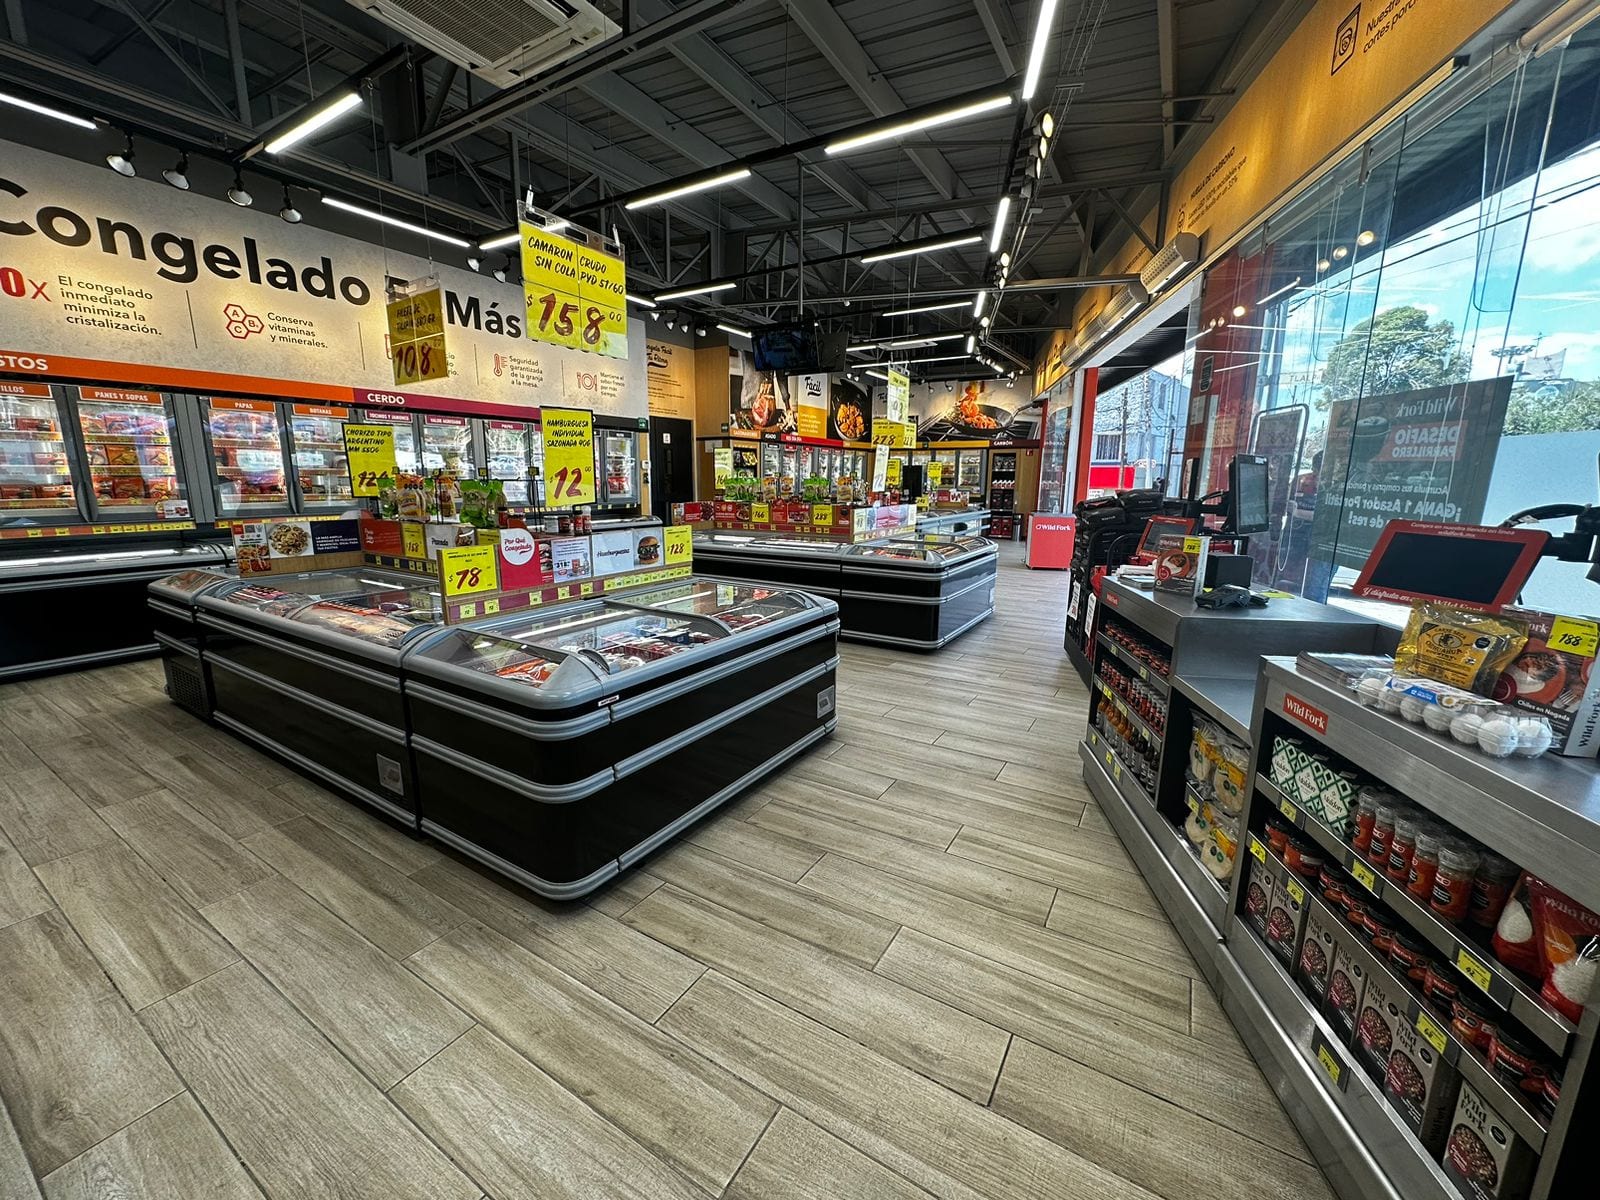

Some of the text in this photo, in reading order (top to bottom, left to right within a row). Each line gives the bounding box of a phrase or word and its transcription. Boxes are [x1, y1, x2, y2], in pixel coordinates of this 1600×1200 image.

[1363, 21, 1391, 53] cortes
[528, 237, 607, 273] CAMARON CRUDO
[535, 256, 552, 270] SIN
[555, 263, 576, 278] COLA
[59, 275, 153, 301] El congelado
[61, 288, 135, 309] inmediato
[64, 302, 146, 322] minimiza la
[267, 312, 314, 327] Conserva
[445, 290, 522, 338] Más
[66, 313, 162, 336] cristalización.
[268, 323, 316, 337] vitaminas
[270, 334, 328, 349] y minerales.
[509, 355, 539, 367] Seguridad
[510, 364, 543, 375] garantizada
[526, 374, 544, 382] granja
[804, 376, 821, 393] Fácil
[95, 391, 117, 399] PANES
[367, 393, 405, 405] CERDO
[346, 429, 374, 437] CHORIZO
[546, 419, 589, 428] HAMBURGUESA
[546, 439, 577, 447] SAZONADA
[1371, 588, 1399, 600] disfruta
[1286, 697, 1326, 730] Wild Fork
[1517, 699, 1536, 711] Chiles
[1544, 708, 1571, 722] Nogada
[1578, 725, 1594, 747] Wild
[1396, 1030, 1416, 1056] Fork
[1398, 1021, 1416, 1046] Wild
[1463, 1087, 1487, 1122] Wild
[1461, 1101, 1486, 1134] Fork
